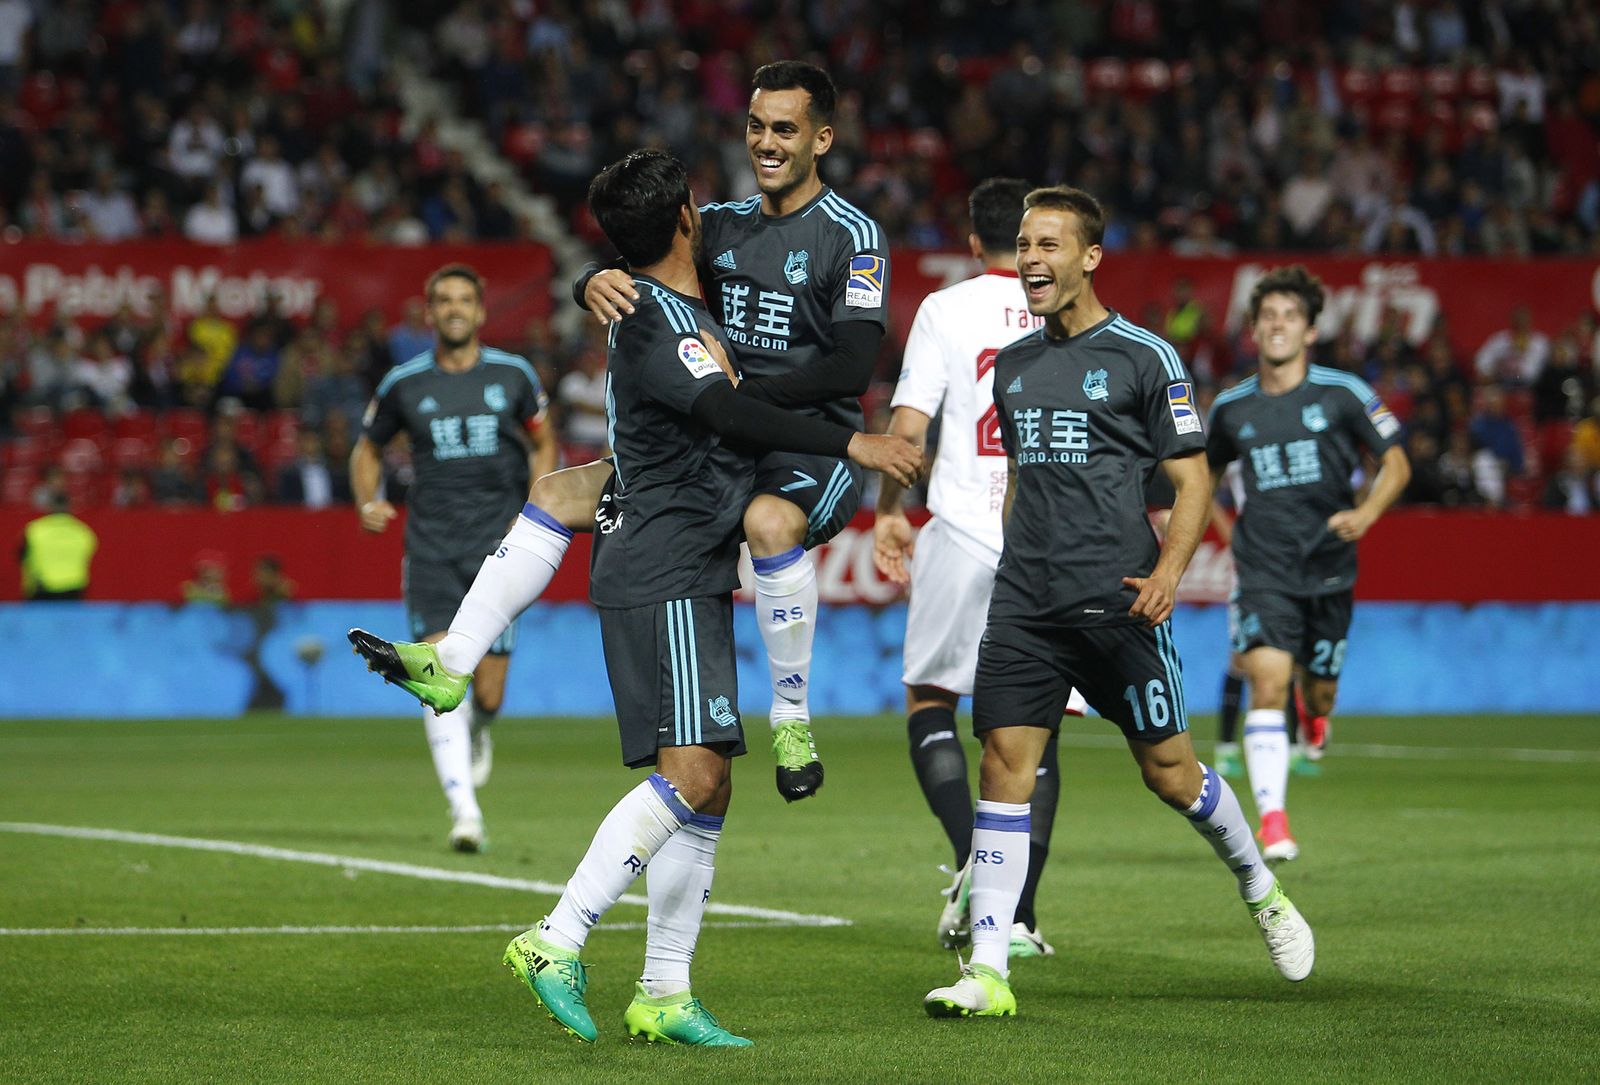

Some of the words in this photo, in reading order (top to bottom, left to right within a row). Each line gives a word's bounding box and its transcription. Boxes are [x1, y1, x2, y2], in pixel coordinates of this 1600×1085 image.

[847, 291, 880, 303] REALE
[724, 326, 788, 351] bao.com
[1176, 417, 1201, 428] REAL
[772, 606, 804, 622] RS
[1122, 678, 1170, 732] 16
[974, 850, 1004, 865] RS
[523, 949, 537, 984] adidas
